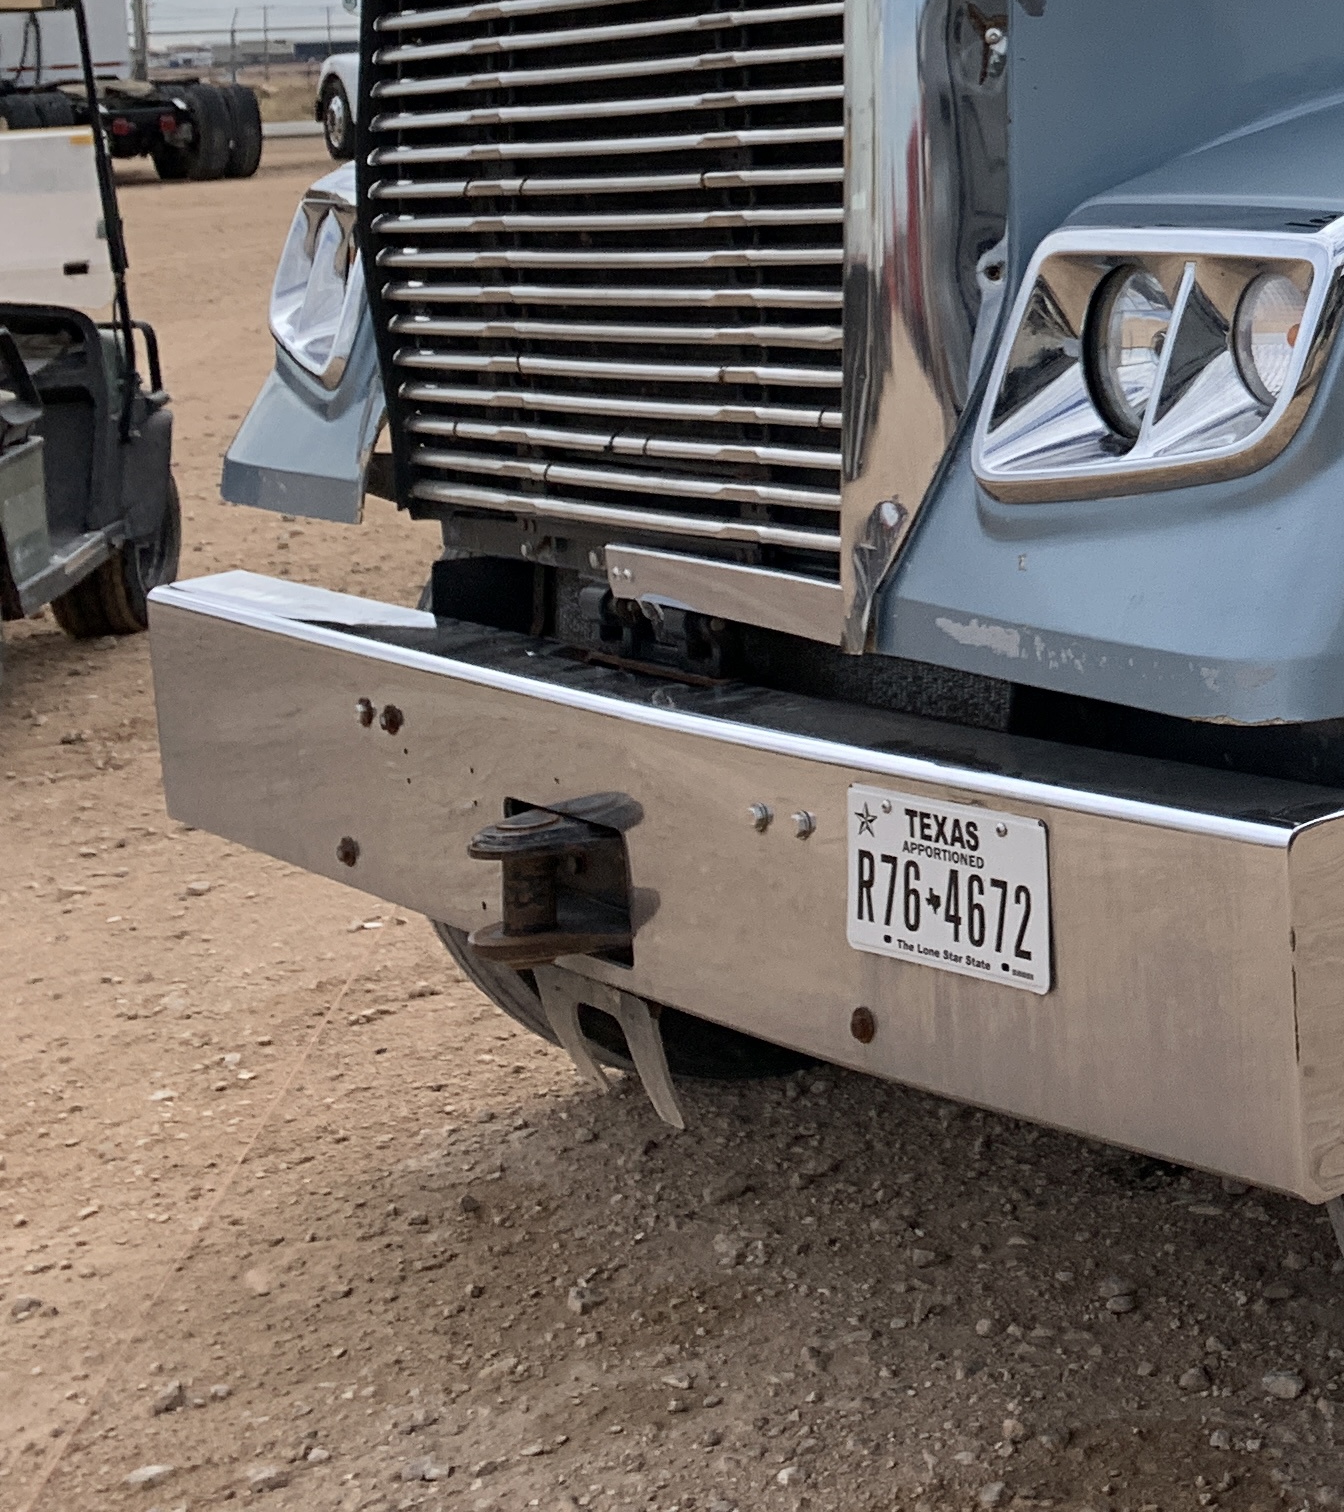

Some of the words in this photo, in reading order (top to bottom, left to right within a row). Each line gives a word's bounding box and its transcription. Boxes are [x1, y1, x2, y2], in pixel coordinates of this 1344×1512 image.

[904, 808, 979, 851] TEXAS
[902, 840, 985, 870] APPORTIONED
[897, 939, 914, 953] The
[917, 944, 940, 959] Lone
[943, 949, 963, 964] Star
[965, 955, 991, 970] State
